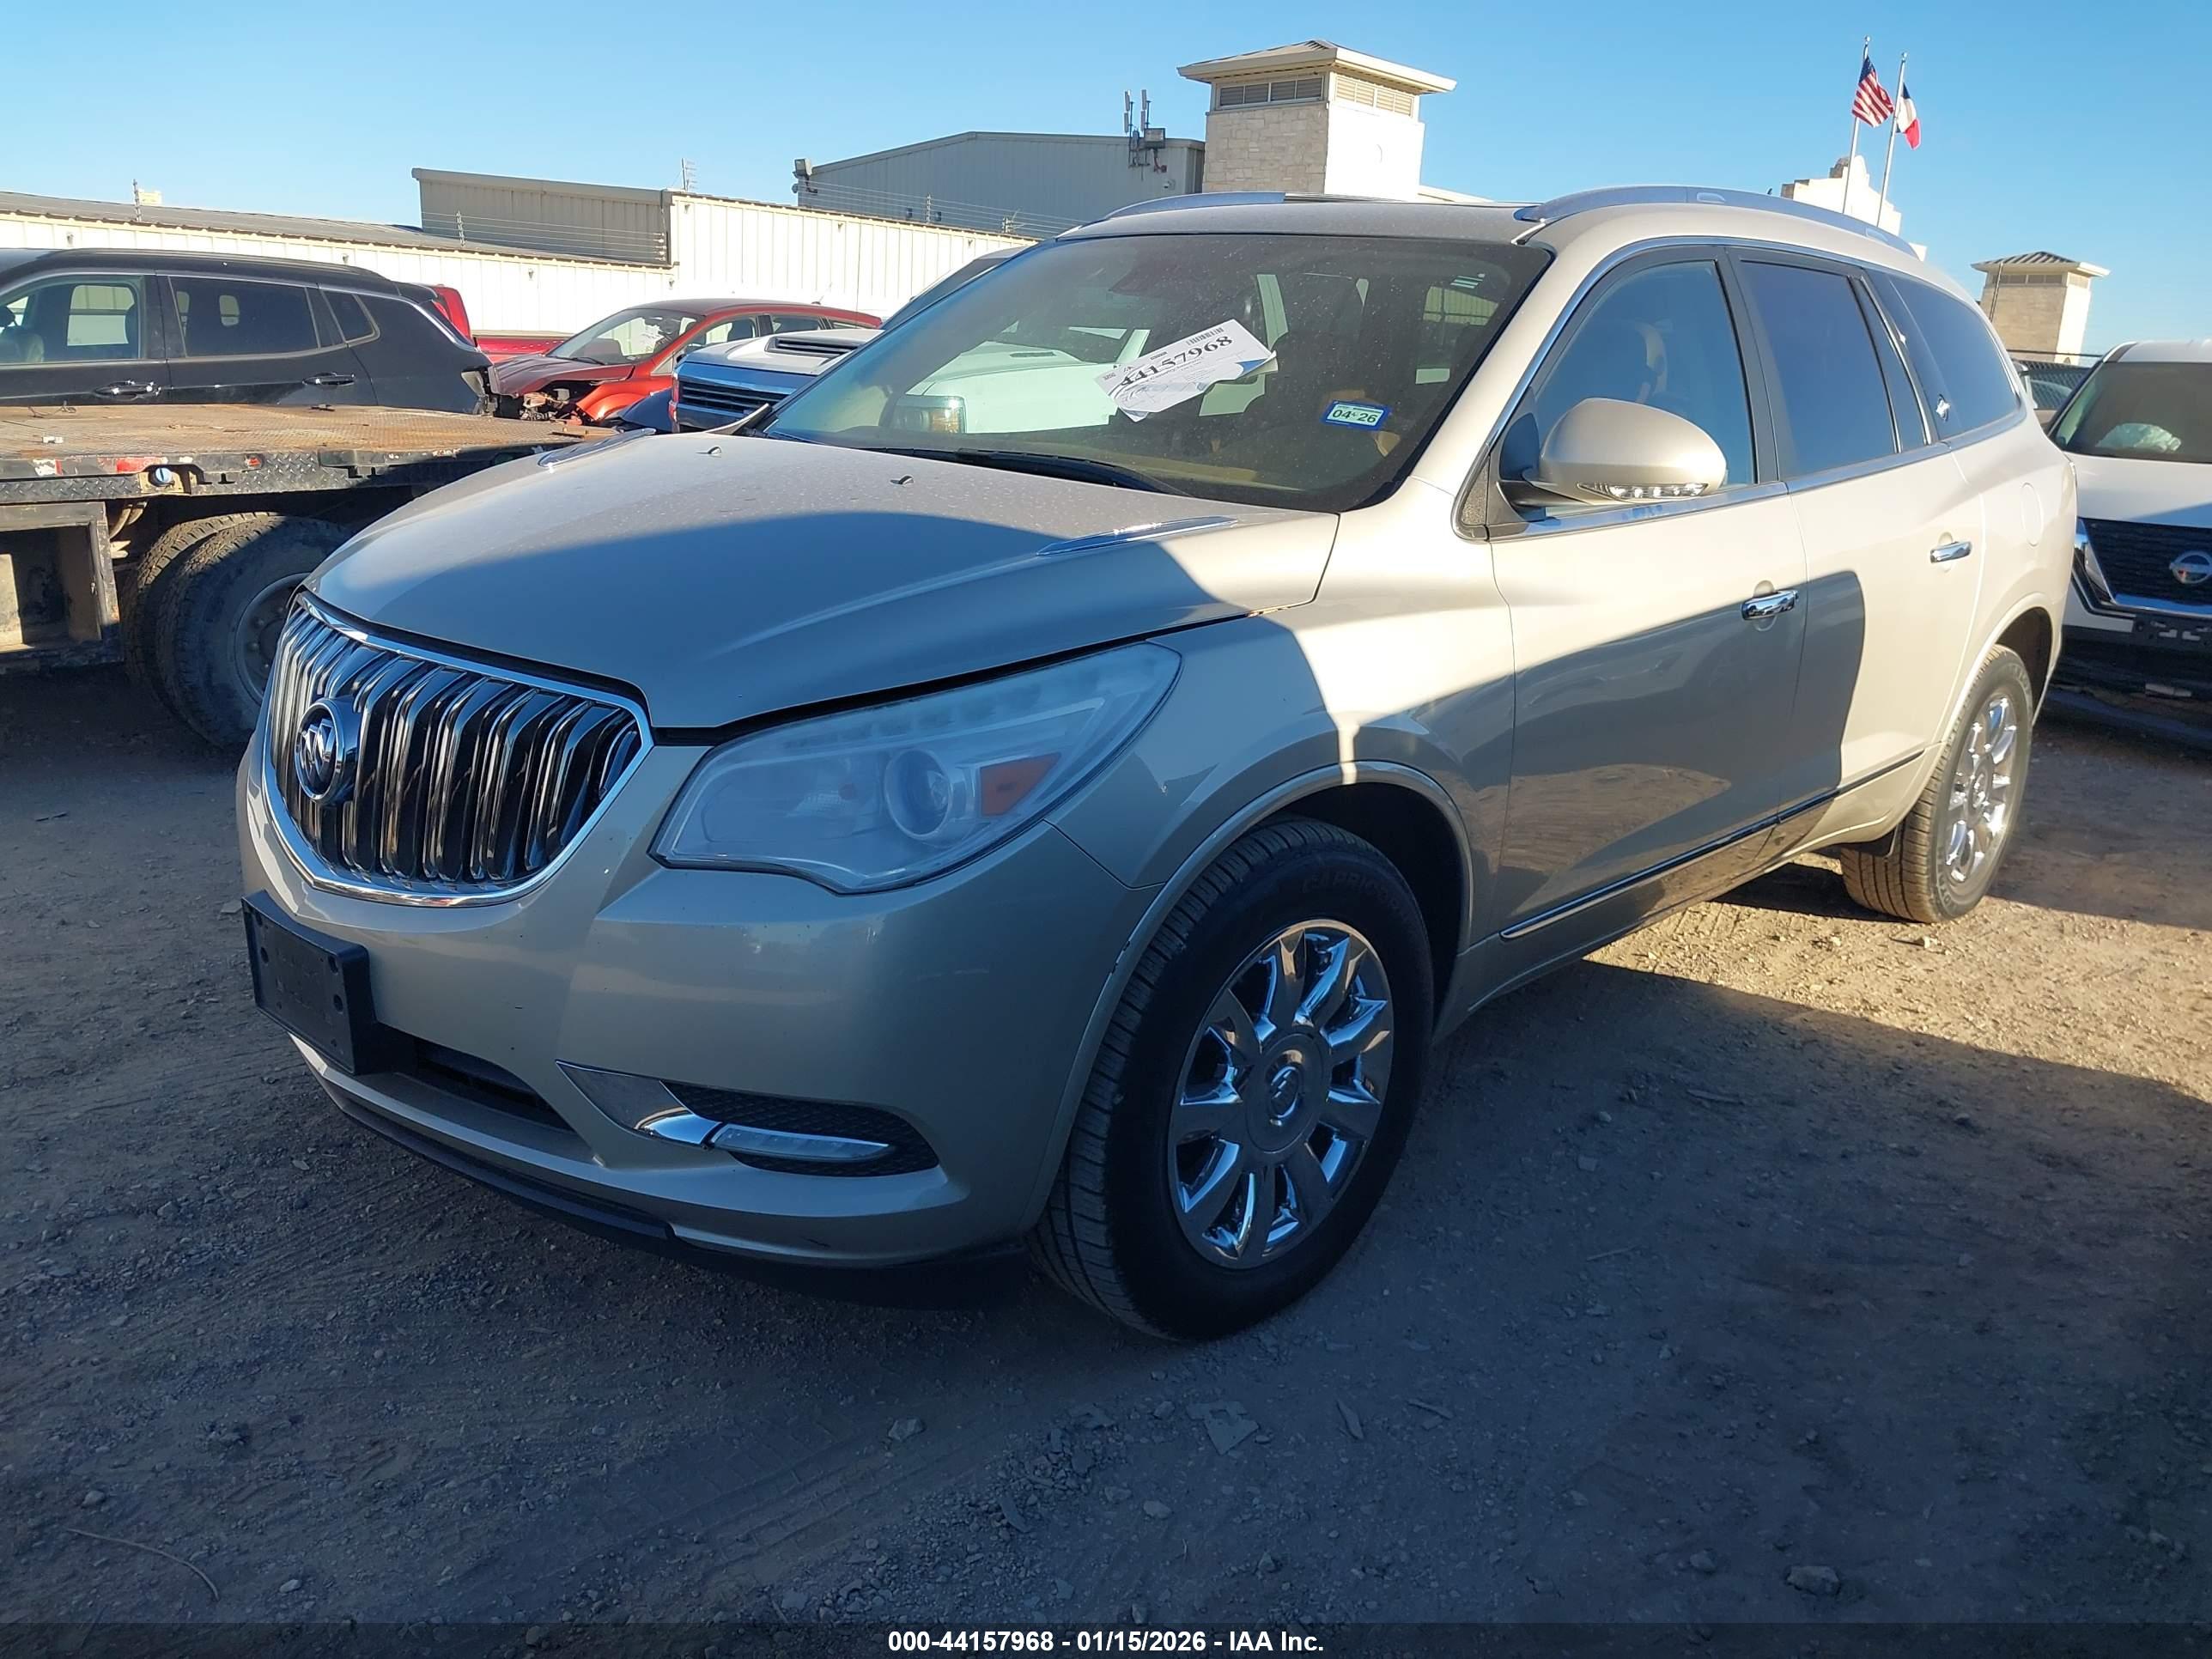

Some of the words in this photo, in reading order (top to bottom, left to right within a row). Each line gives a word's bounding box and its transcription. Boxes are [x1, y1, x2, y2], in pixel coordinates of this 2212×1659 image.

[1121, 336, 1233, 386] 44157968
[1332, 410, 1352, 419] 04
[1357, 412, 1378, 423] 26
